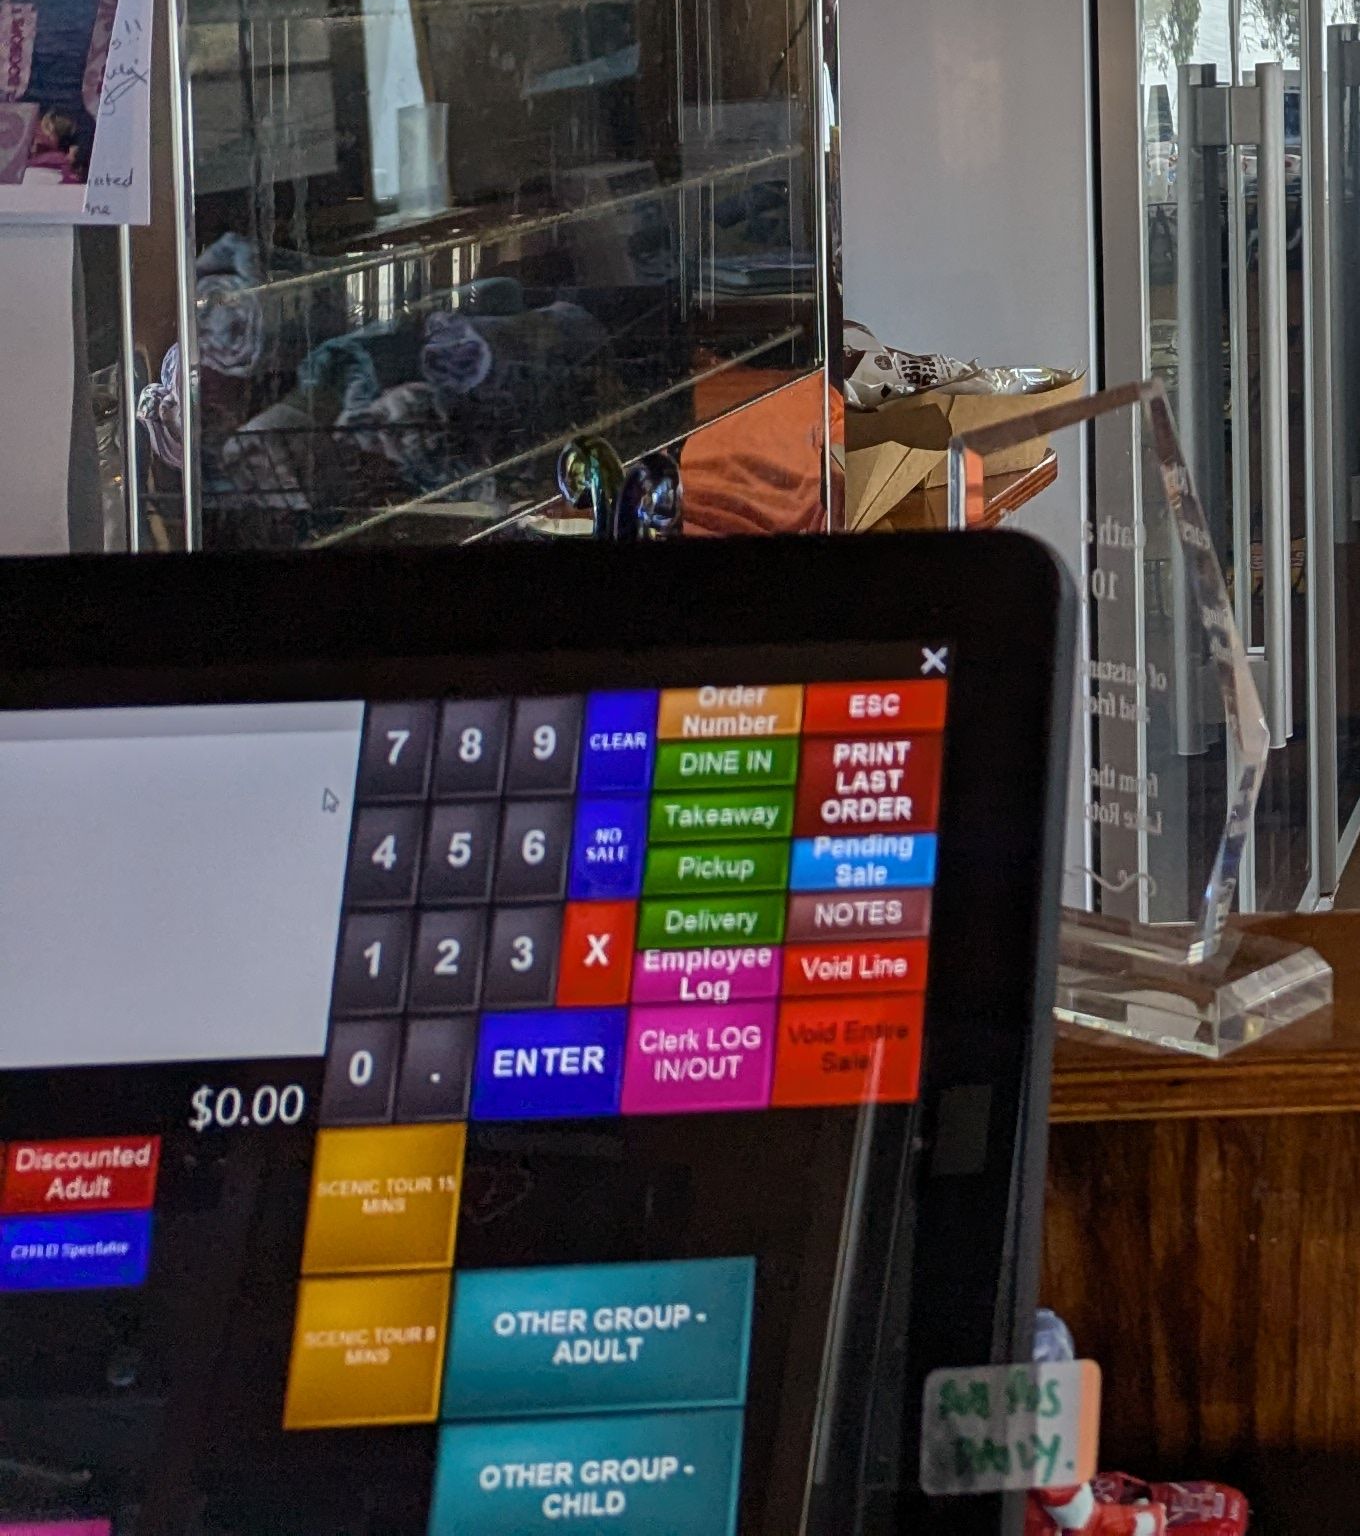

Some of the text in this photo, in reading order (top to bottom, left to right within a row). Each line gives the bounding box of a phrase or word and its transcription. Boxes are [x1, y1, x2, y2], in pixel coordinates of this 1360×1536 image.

[699, 685, 766, 707] Order
[848, 694, 900, 717] ESC
[683, 712, 777, 737] Number
[387, 730, 409, 764] 7
[459, 727, 482, 762] 8
[533, 725, 556, 759] 9
[589, 732, 647, 750] CLEAR
[833, 741, 910, 765] PRINT
[680, 750, 773, 776] DINE IN
[836, 768, 904, 794] LAST
[665, 803, 779, 831] Takeaway
[820, 796, 913, 823] ORDER
[372, 834, 397, 869] 4
[448, 832, 471, 866] 5
[522, 830, 546, 863] 6
[813, 834, 914, 862] Pending
[679, 856, 755, 880] Pickup
[835, 864, 888, 887] Sale
[666, 909, 759, 936] Delivery
[814, 900, 903, 926] NOTES
[364, 942, 381, 977] 1
[434, 939, 459, 975] 2
[511, 936, 534, 971] 3
[584, 934, 609, 966] X
[643, 947, 772, 972] Employee
[801, 954, 908, 980] Void Line
[680, 978, 730, 1003] Log
[639, 1025, 762, 1053] Clerk LOG
[788, 1021, 838, 1046] Void
[350, 1051, 373, 1084] 0
[493, 1045, 605, 1077] ENTER
[653, 1056, 742, 1082] IN/OUT
[821, 1052, 871, 1074] Sale
[189, 1084, 305, 1127] $0.00
[15, 1143, 151, 1172] Discounted
[44, 1173, 112, 1202] Adult
[317, 1178, 381, 1197] SCENIC
[386, 1175, 432, 1193] TOUR
[495, 1308, 586, 1336] OTHER
[593, 1304, 690, 1331] GROUP
[373, 1325, 423, 1344] TOUR
[552, 1337, 643, 1364] ADULT
[480, 1463, 573, 1491] OTHER
[581, 1457, 682, 1485] GROUP
[542, 1491, 626, 1519] CHILD
